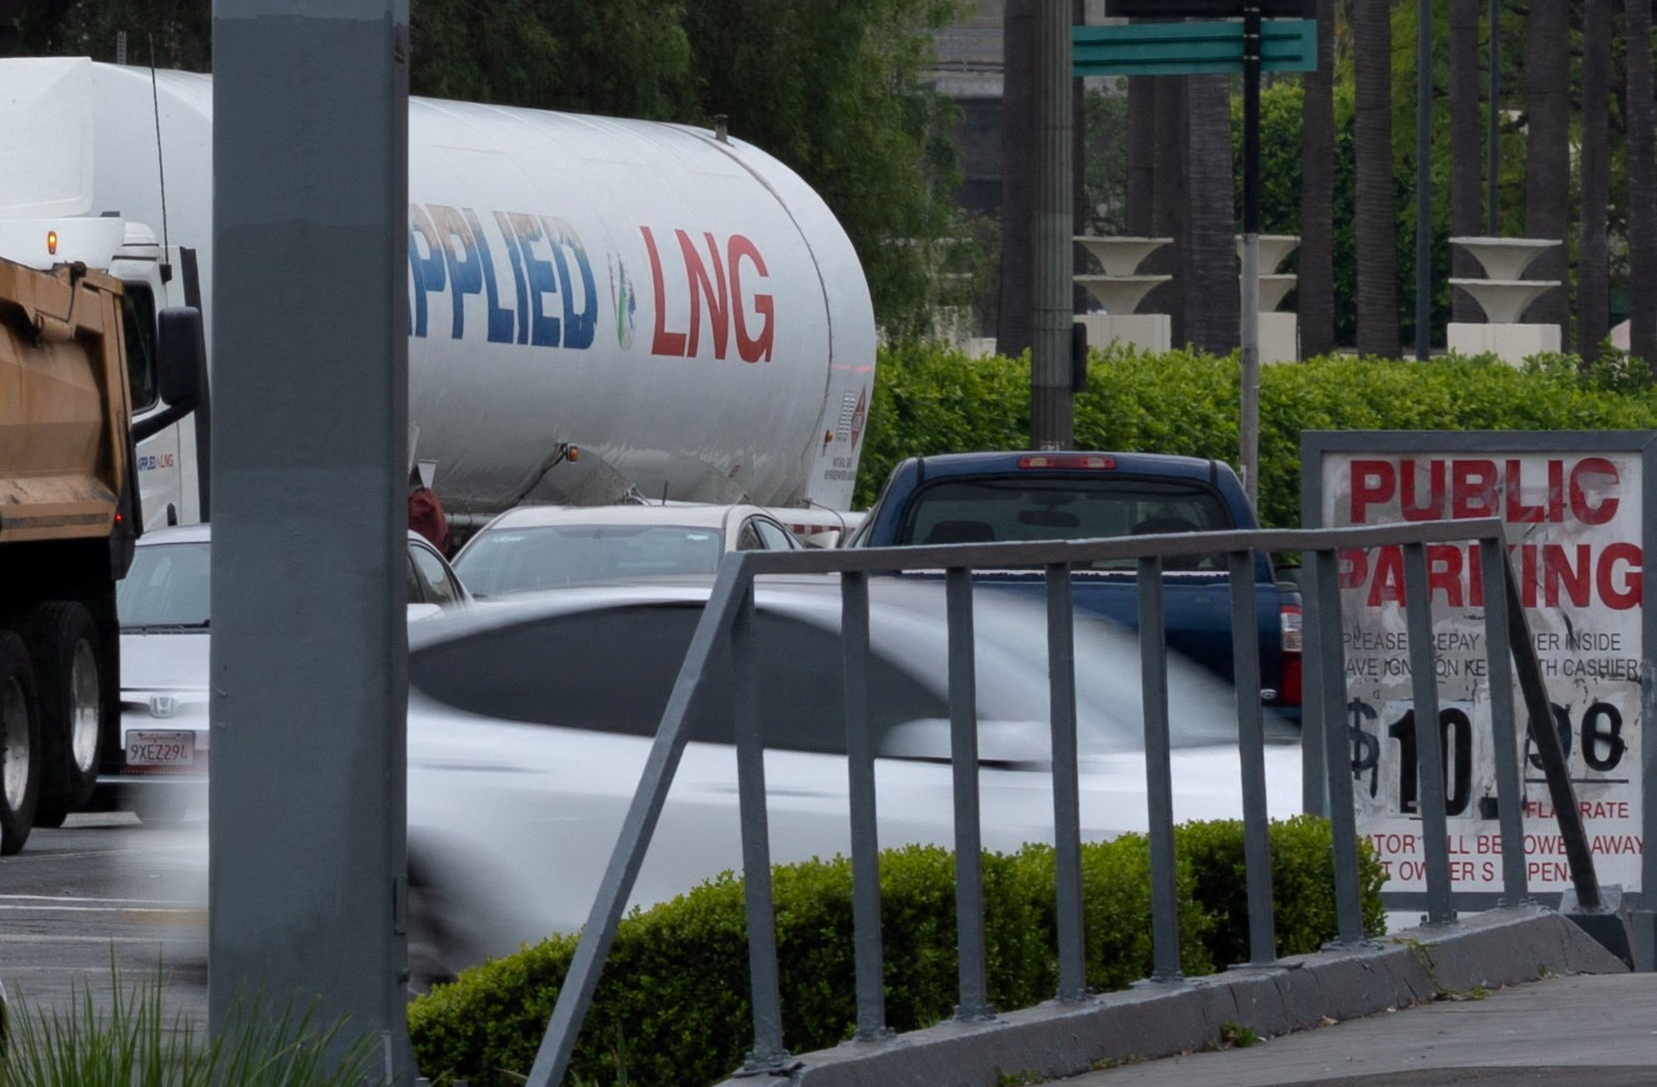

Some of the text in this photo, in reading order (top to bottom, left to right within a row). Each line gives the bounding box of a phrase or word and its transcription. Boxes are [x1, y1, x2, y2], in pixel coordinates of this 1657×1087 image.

[408, 202, 776, 364] PPLIED LNG
[1349, 457, 1621, 526] PUBLIC
[1342, 632, 1408, 651] PLEASE
[1430, 632, 1480, 652] EPAY
[1565, 632, 1622, 652] INSIDE
[1345, 657, 1378, 676] AVE
[1464, 658, 1487, 677] KE
[1538, 658, 1558, 677] TH
[1562, 658, 1638, 679] CASHIER
[1526, 801, 1630, 819] FLA RATE
[1476, 834, 1503, 855] BE
[1590, 834, 1645, 855] AWAY
[1398, 860, 1476, 881] OWER
